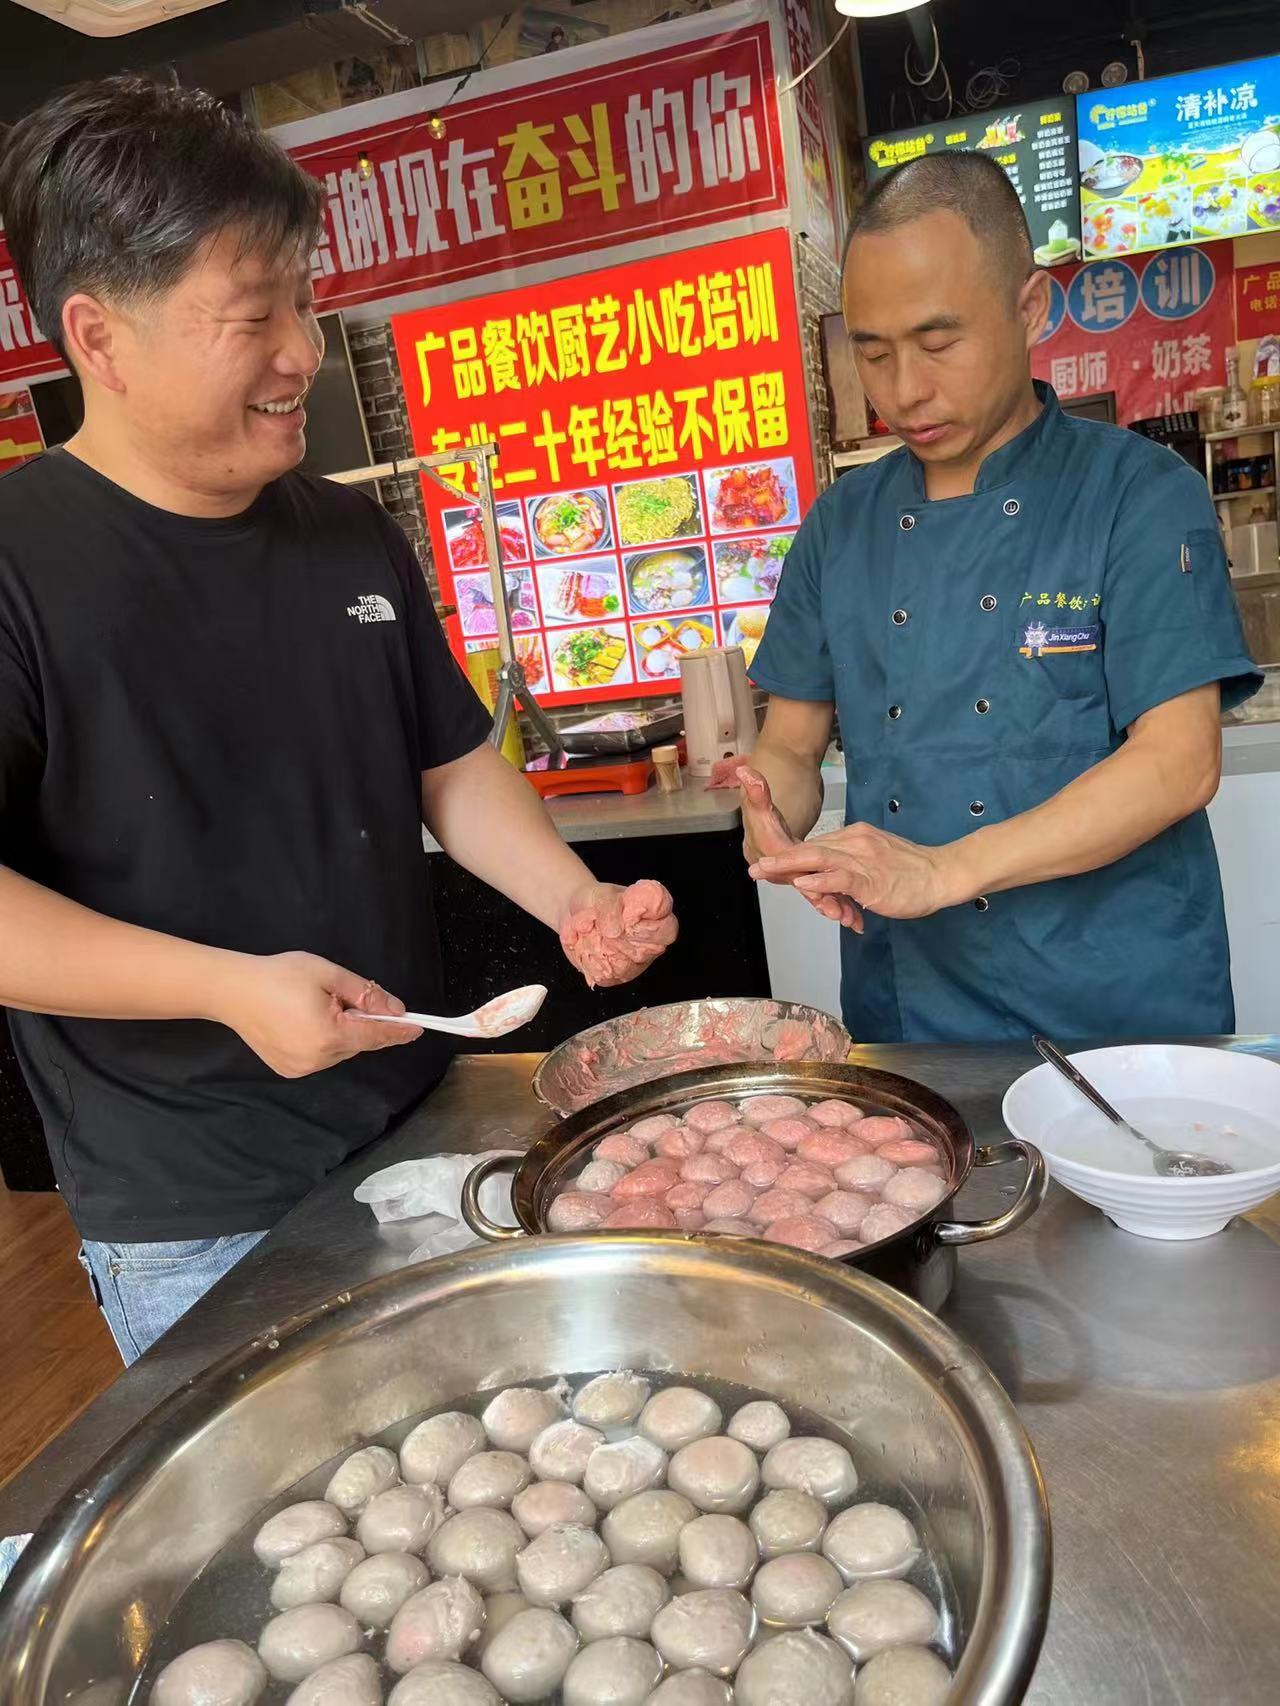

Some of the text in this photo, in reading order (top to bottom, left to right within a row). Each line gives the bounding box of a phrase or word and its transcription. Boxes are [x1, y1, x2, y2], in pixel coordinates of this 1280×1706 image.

[1175, 81, 1259, 122] 清补凉
[311, 72, 761, 278] 谢现在奋斗的你
[1047, 252, 1201, 331] 培训
[415, 262, 780, 408] 广品餐饮厨艺小吃培训
[1051, 333, 1213, 395] 厨师 奶茶
[431, 371, 789, 494] 专业二十年经验不保留
[347, 604, 379, 617] NORTH
[357, 595, 377, 605] THE
[358, 613, 382, 624] FACE
